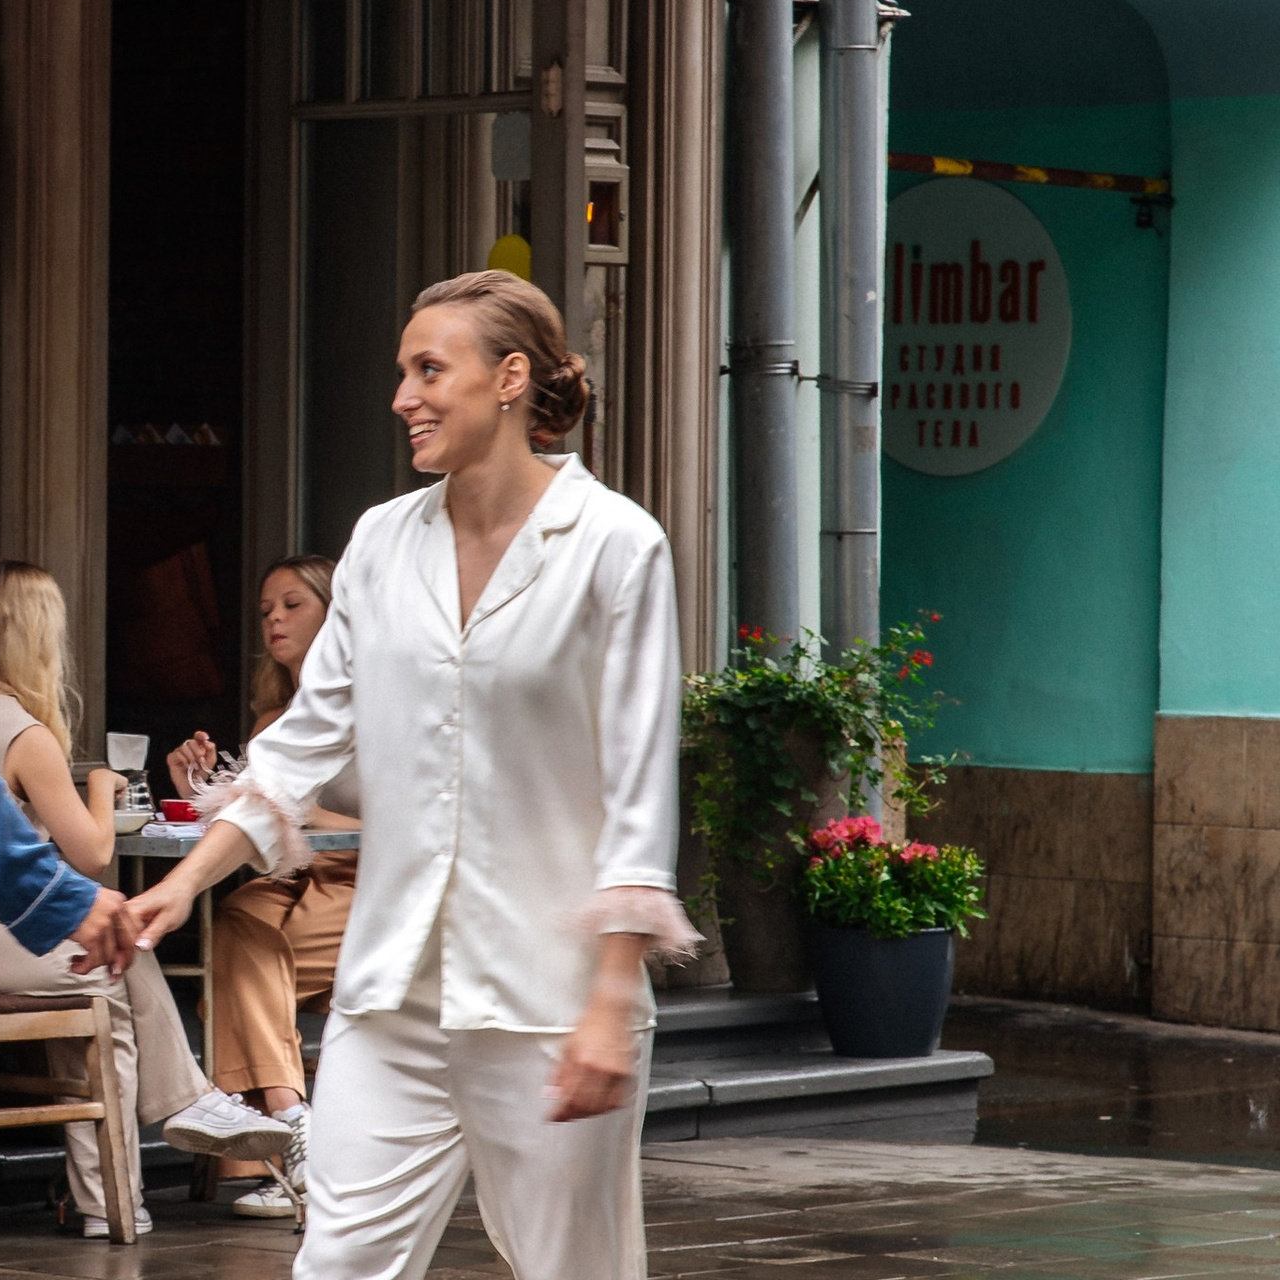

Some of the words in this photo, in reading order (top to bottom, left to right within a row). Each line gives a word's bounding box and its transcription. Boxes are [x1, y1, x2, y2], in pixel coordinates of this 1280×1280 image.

[883, 238, 1046, 324] limbar
[899, 344, 1001, 375] СТУДИЯ
[890, 381, 1022, 410] РАСИВОГО
[917, 419, 980, 448] ТЕЛА
